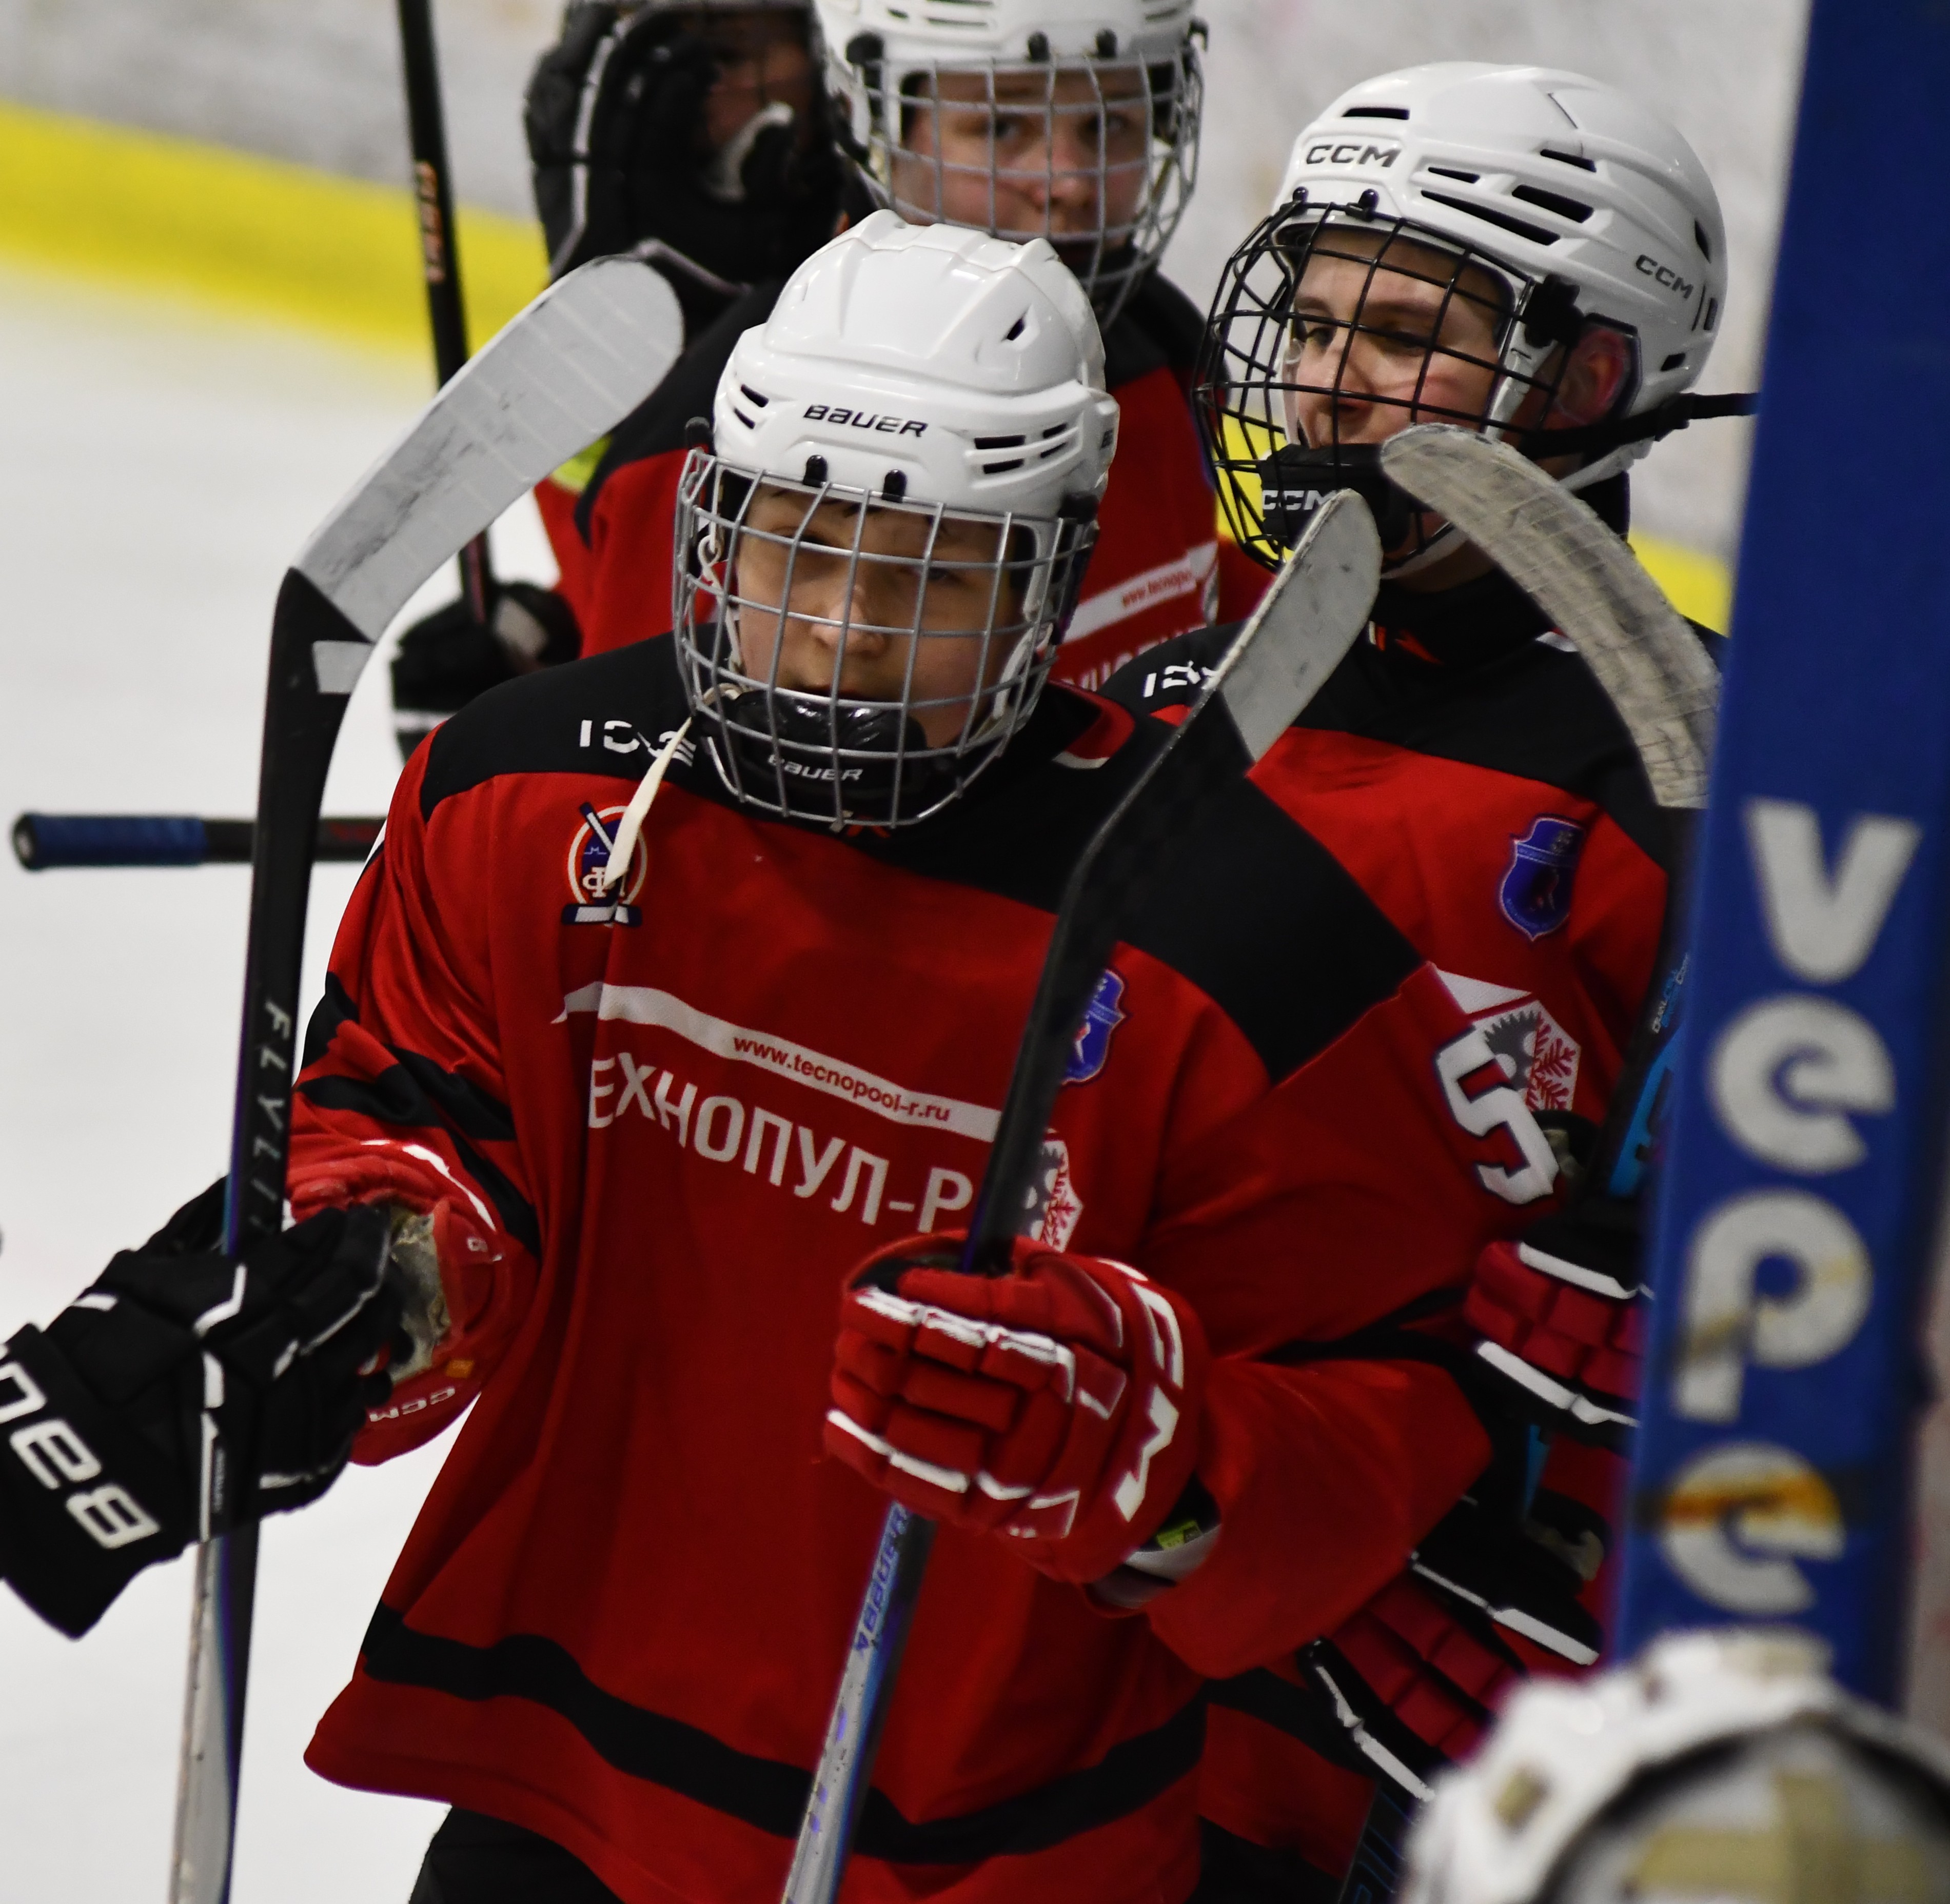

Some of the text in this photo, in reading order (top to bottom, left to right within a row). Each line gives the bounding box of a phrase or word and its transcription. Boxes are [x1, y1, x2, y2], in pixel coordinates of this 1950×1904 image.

[1305, 143, 1402, 168] CCM
[1635, 254, 1693, 300] CCM
[803, 403, 929, 438] BAUER
[734, 1036, 951, 1121] www.tecnopool-r.ru
[369, 1386, 456, 1422] CCM
[0, 1341, 161, 1549] BAU
